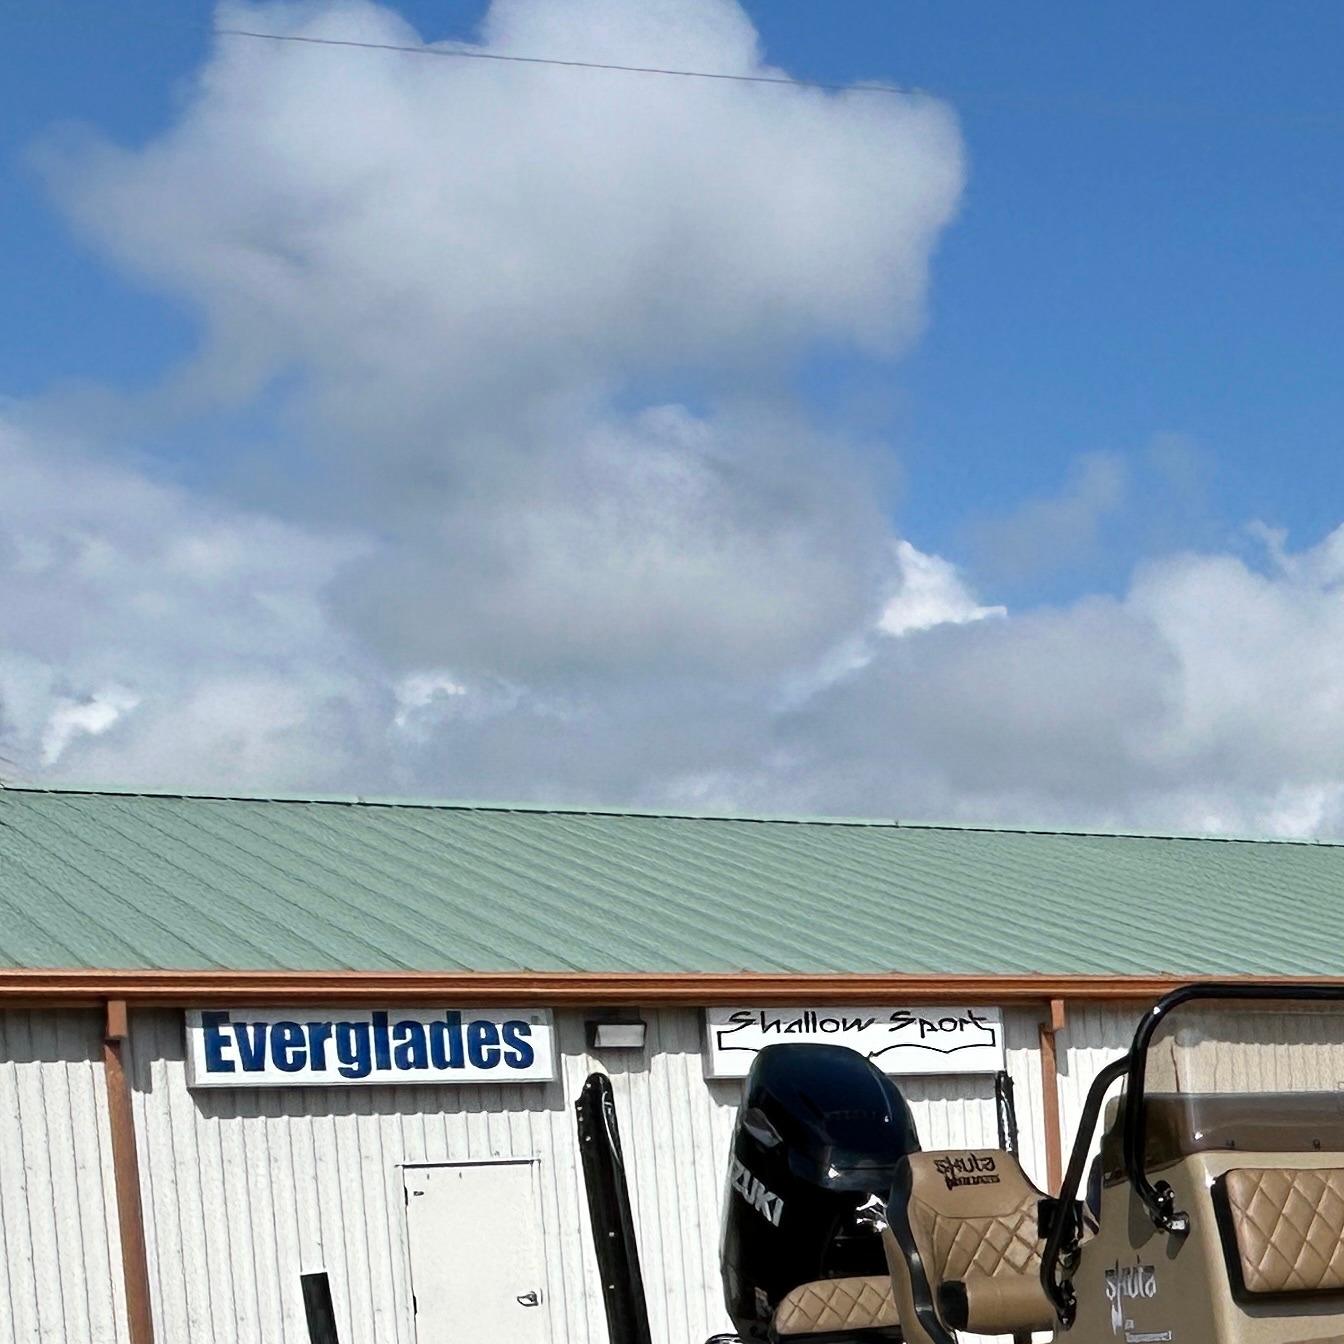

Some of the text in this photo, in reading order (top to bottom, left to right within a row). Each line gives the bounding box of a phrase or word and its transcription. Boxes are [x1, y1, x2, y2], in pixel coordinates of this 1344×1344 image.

[201, 1011, 534, 1078] Everglades
[728, 1010, 988, 1038] Shallow Sport
